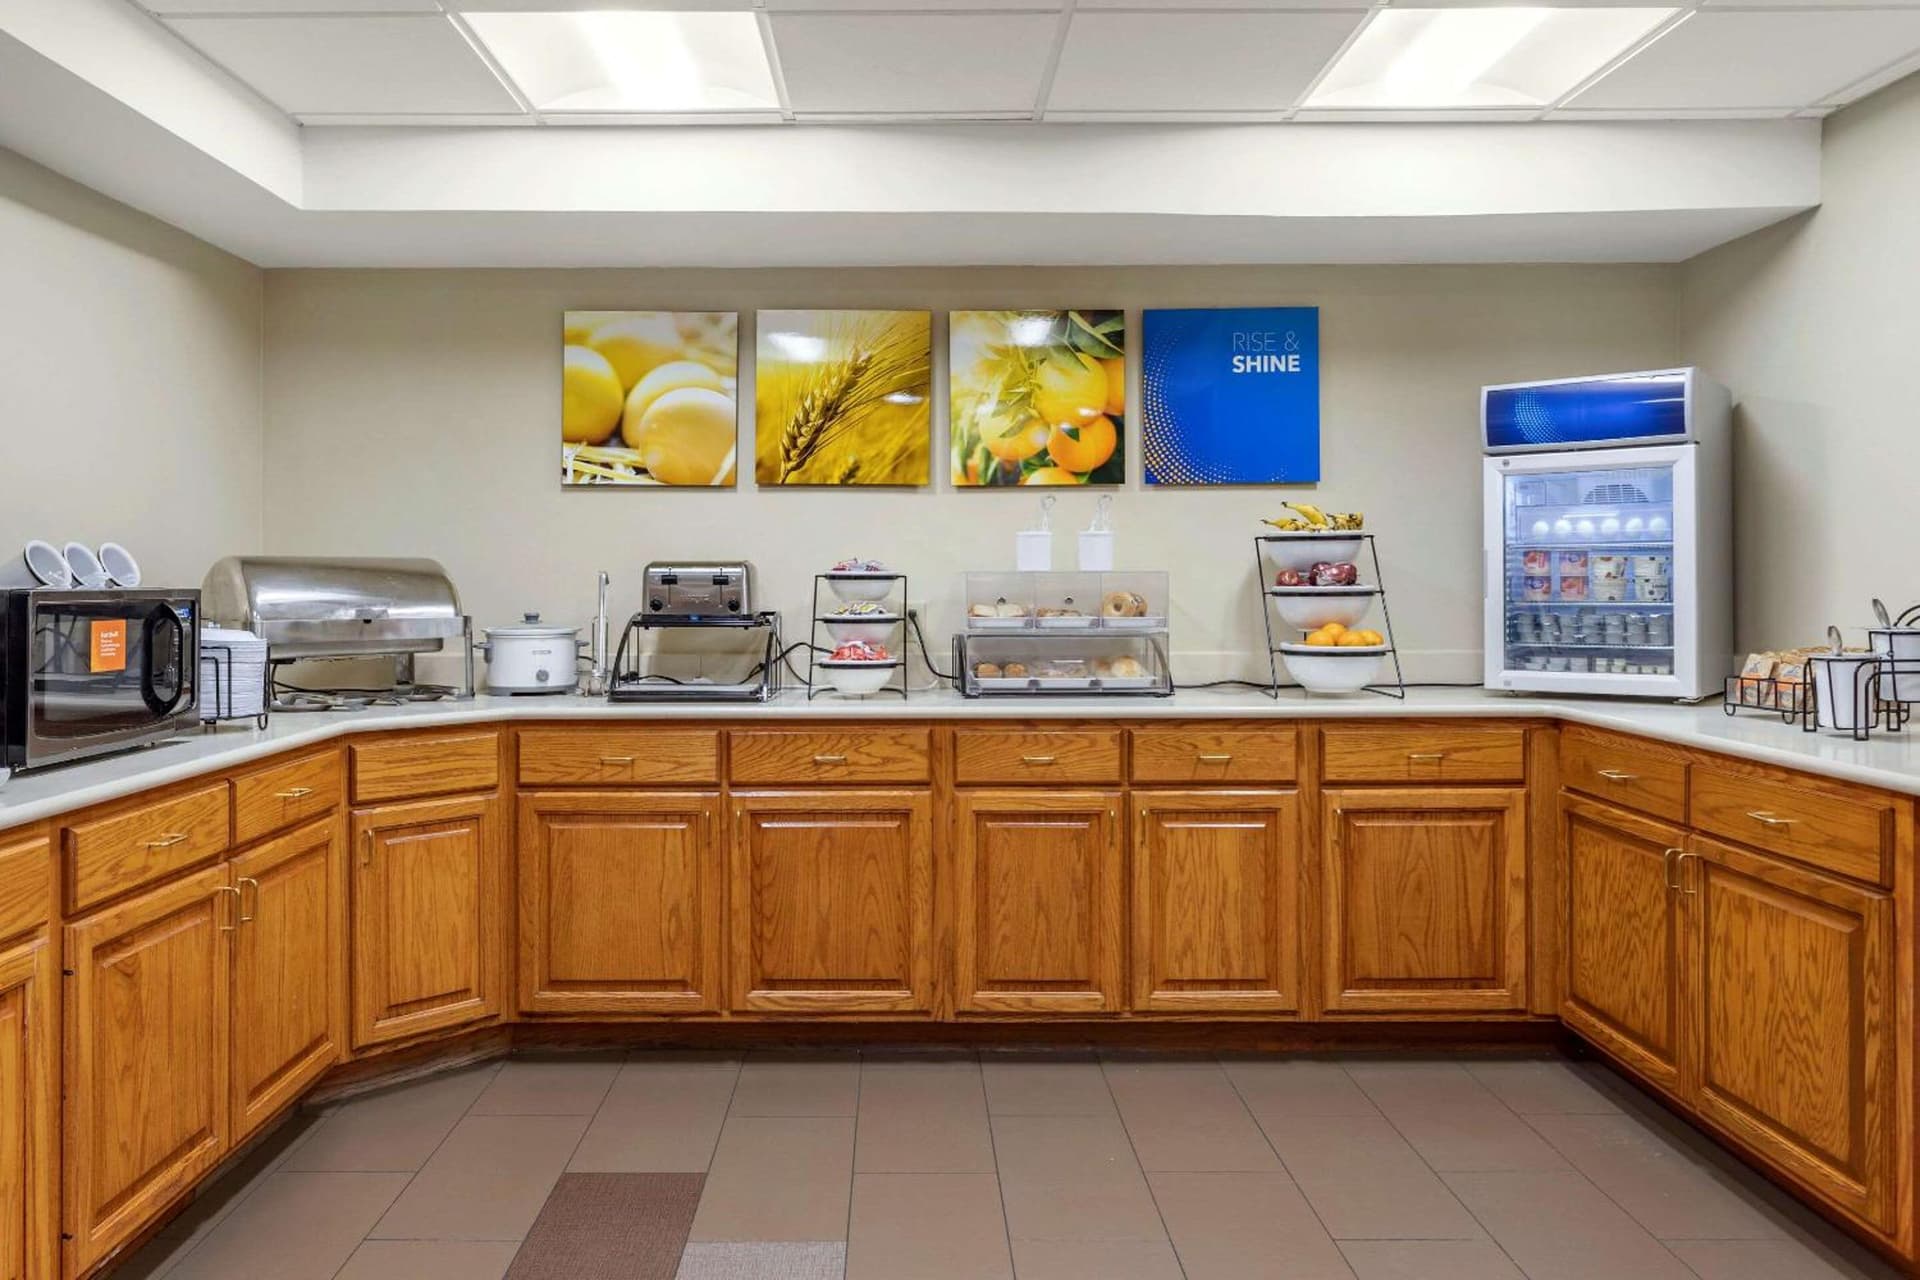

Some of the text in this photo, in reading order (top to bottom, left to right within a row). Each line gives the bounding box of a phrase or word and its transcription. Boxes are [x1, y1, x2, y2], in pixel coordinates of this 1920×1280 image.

[1233, 331, 1300, 352] RISE &
[1232, 355, 1301, 373] SHINE
